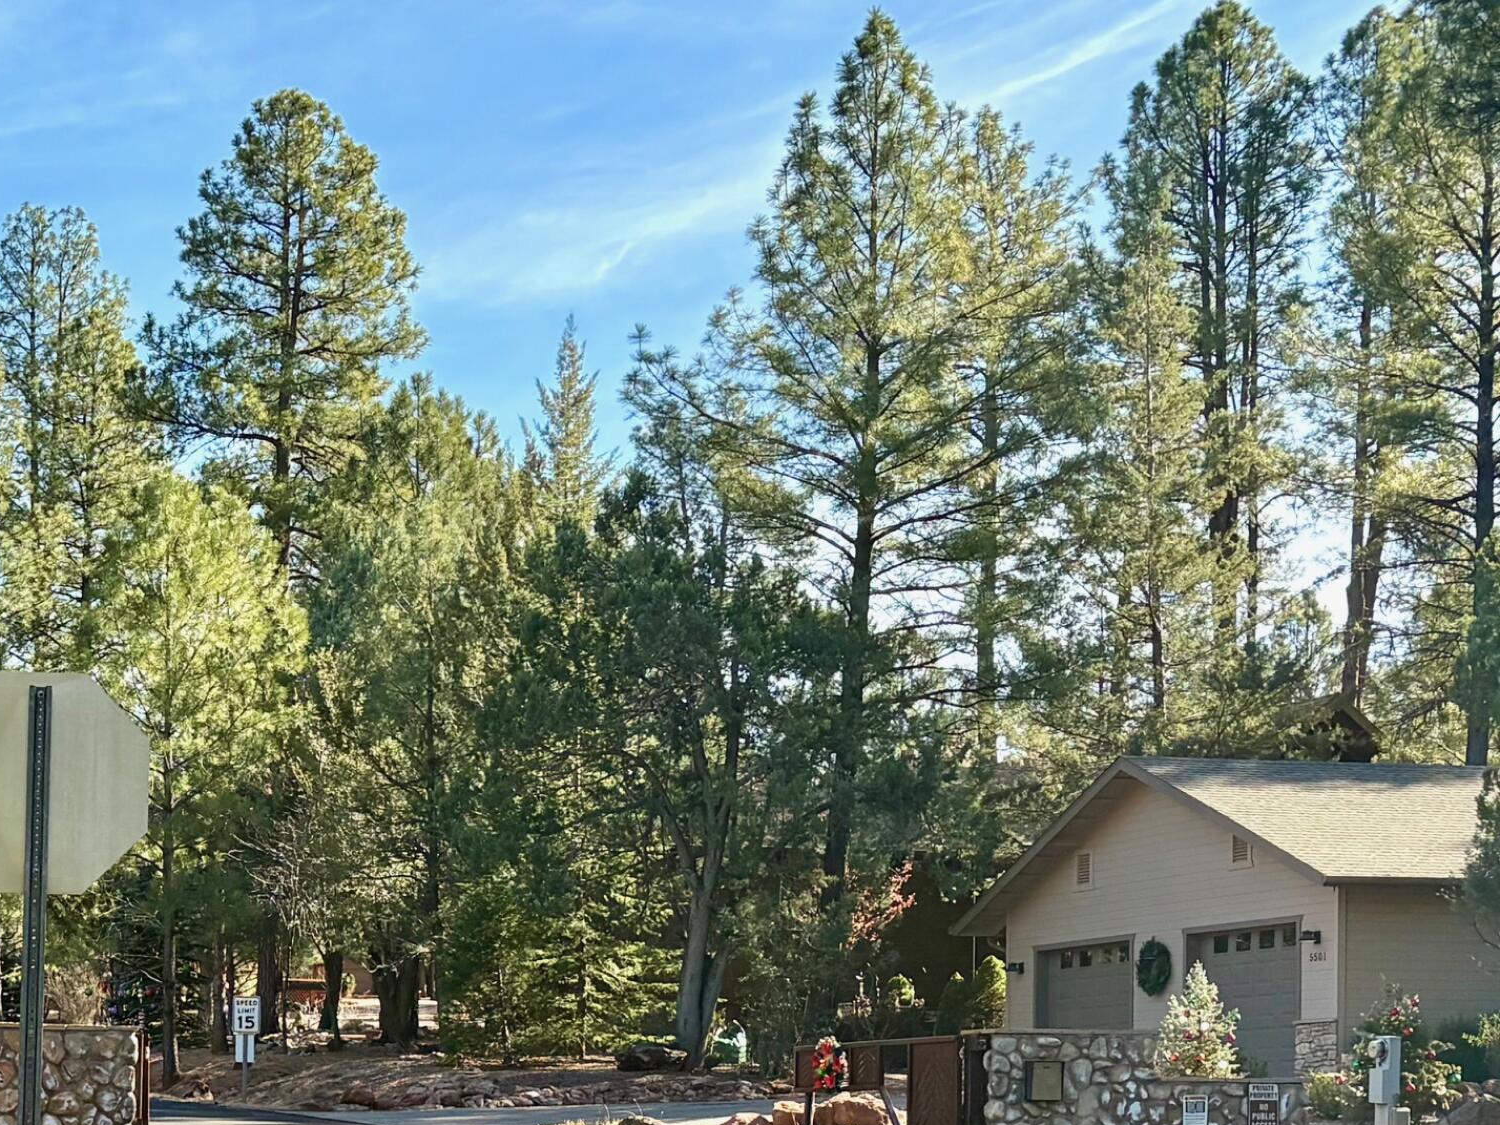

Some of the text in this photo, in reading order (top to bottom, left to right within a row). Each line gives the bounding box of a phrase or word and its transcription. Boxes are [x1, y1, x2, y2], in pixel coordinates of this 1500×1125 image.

[237, 1015, 255, 1029] 15
[1258, 1103, 1269, 1111] NO
[1251, 1112, 1276, 1120] PUBLIC
